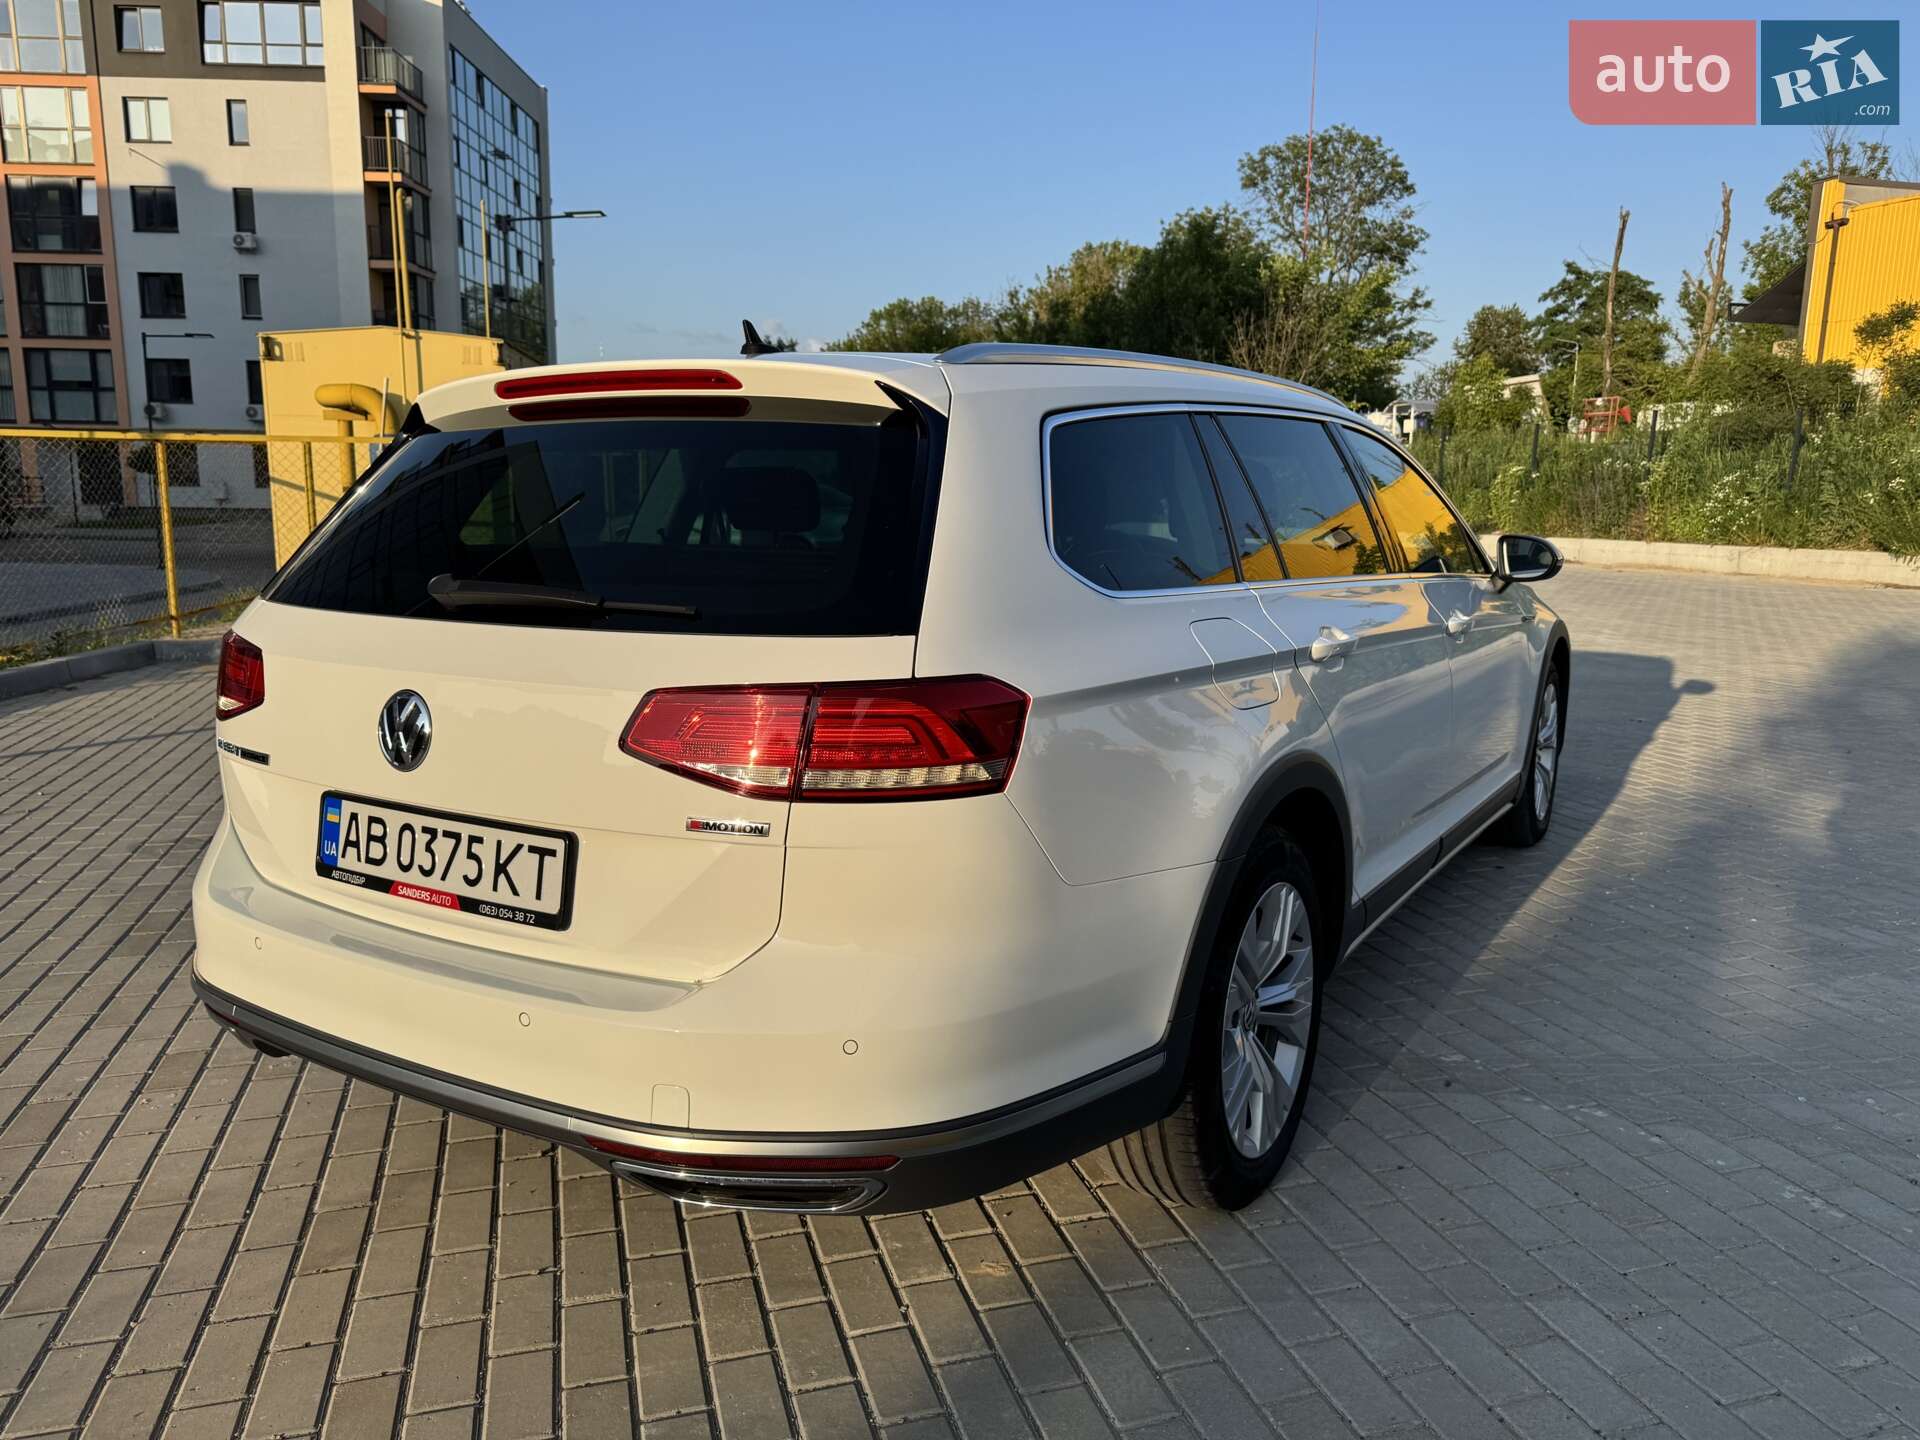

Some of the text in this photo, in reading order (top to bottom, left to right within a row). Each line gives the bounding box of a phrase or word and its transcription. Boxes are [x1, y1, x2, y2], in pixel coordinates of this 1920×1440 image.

[324, 840, 337, 857] UA
[397, 885, 452, 906] SANDERS AUTO
[479, 904, 535, 924] (063) 054 38 72
